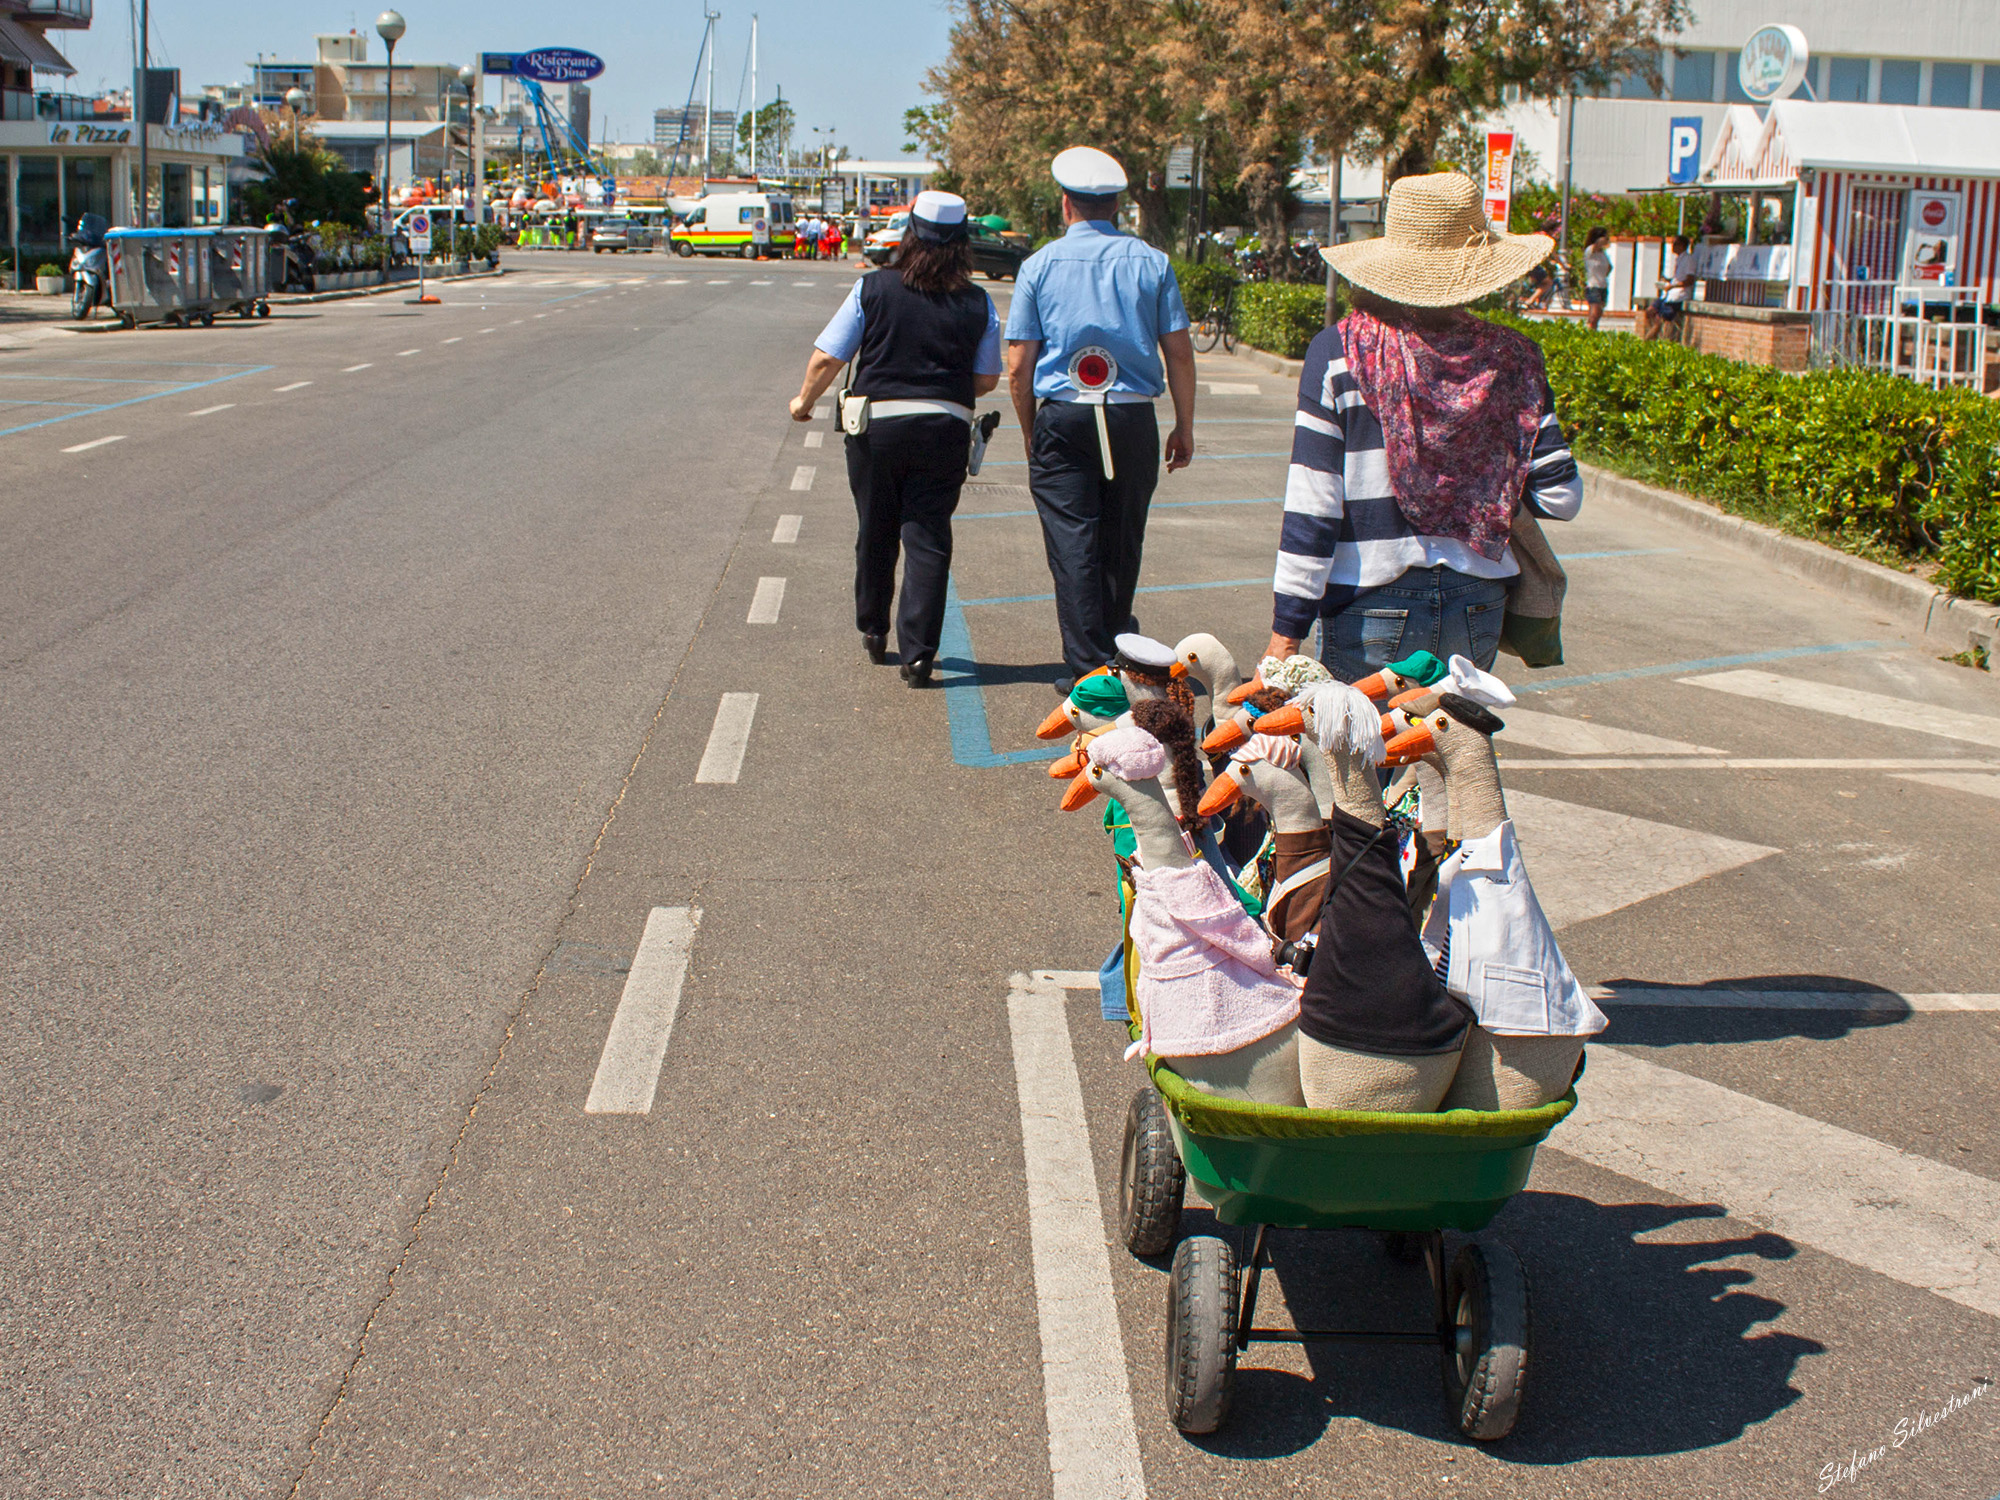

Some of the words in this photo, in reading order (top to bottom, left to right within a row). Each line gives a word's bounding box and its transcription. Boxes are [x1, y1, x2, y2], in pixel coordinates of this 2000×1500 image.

[526, 52, 597, 69] Ristorante
[551, 66, 587, 79] Dina
[50, 123, 70, 143] la
[75, 123, 131, 143] Pizza
[1671, 127, 1698, 174] P
[749, 166, 786, 175] IRCOLO
[1070, 350, 1088, 373] Comune
[1099, 350, 1114, 368] Cervia
